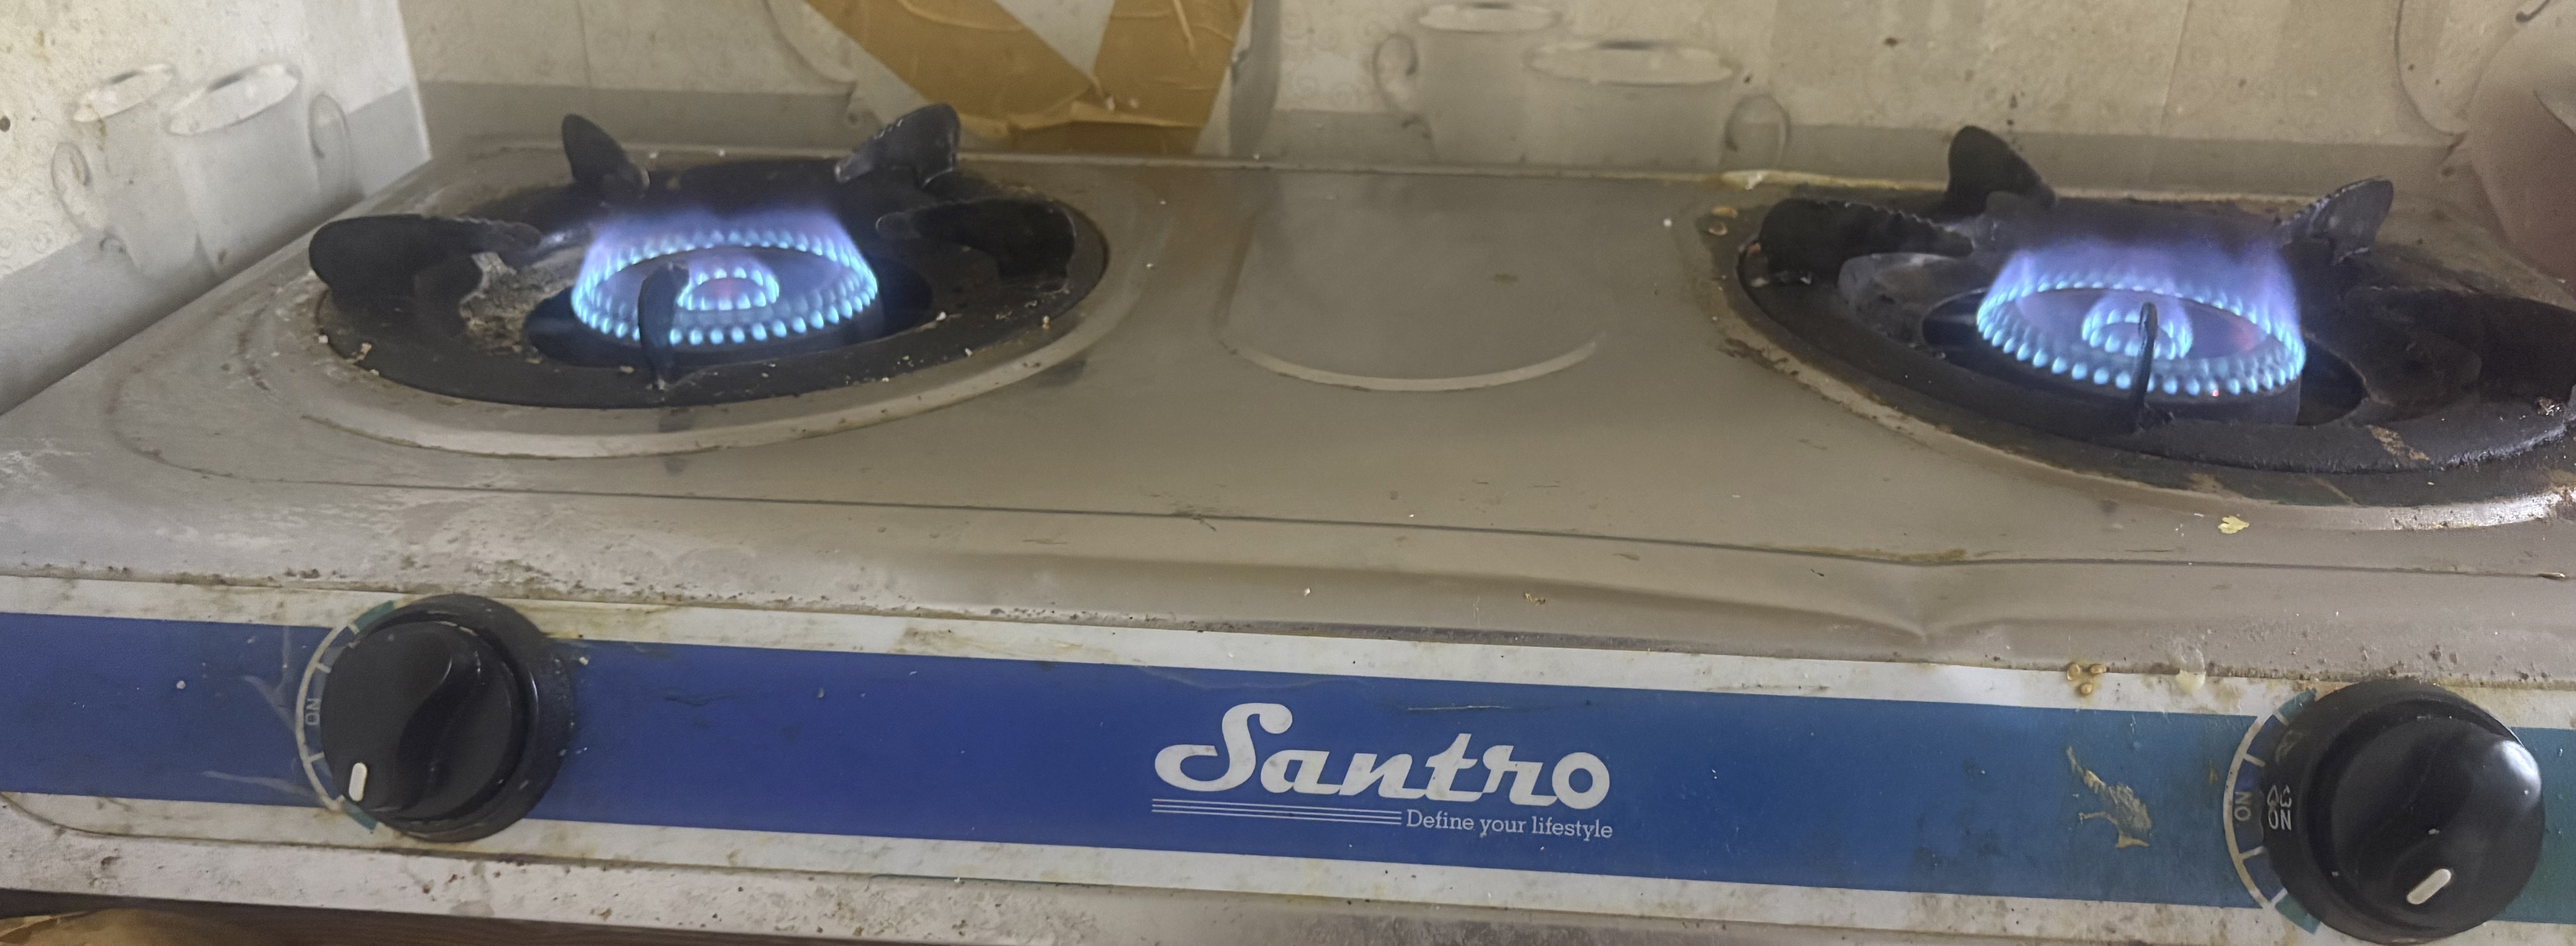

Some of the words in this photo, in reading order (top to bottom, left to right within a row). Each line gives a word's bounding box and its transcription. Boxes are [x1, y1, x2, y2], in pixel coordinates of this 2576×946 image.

[306, 698, 321, 725] ON
[1155, 702, 1610, 809] Santro
[2234, 791, 2251, 821] ON
[2268, 809, 2291, 830] ON
[1406, 809, 1475, 830] Define
[1480, 818, 1527, 838] your
[1532, 816, 1613, 841] lifestyle
